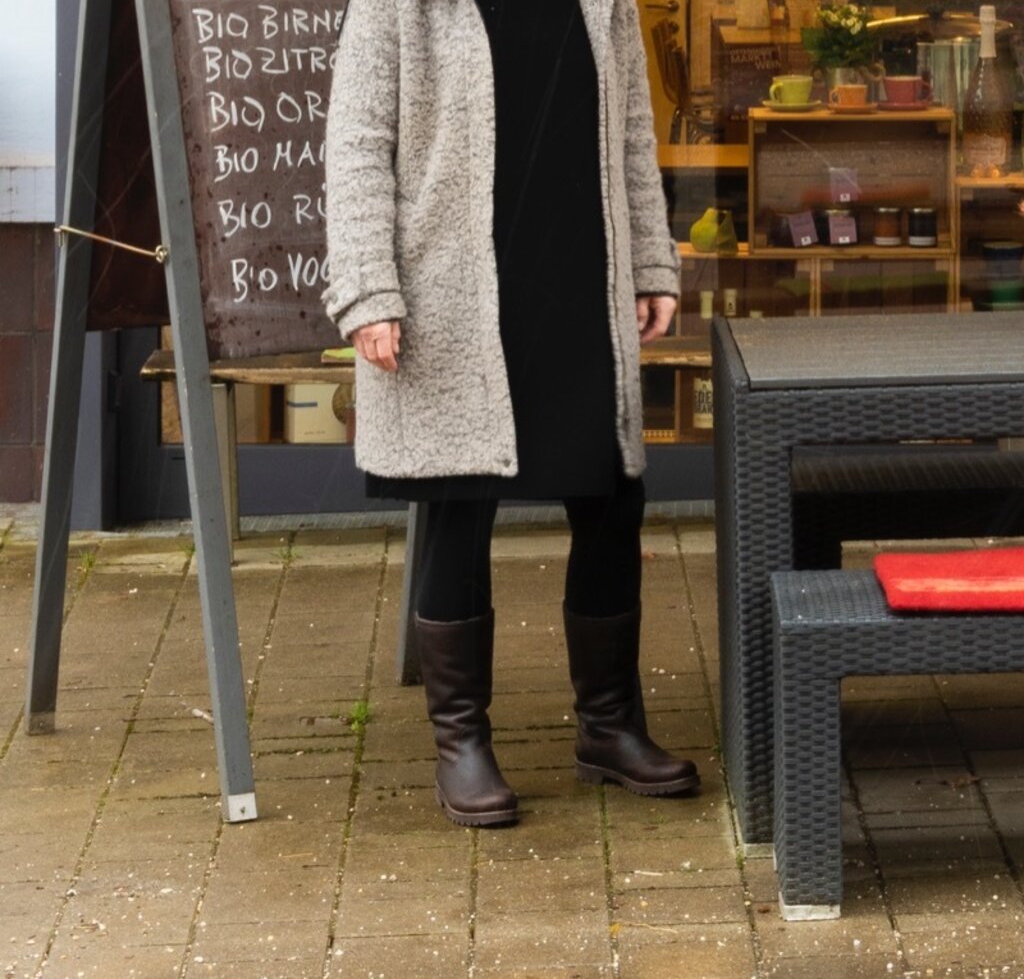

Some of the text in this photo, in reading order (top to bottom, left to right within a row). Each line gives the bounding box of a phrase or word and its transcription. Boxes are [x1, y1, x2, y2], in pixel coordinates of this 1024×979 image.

[192, 8, 249, 43] BIO
[202, 46, 253, 83] BIO
[207, 91, 265, 133] BIO
[213, 144, 259, 183] BIO
[217, 199, 272, 238] BIO
